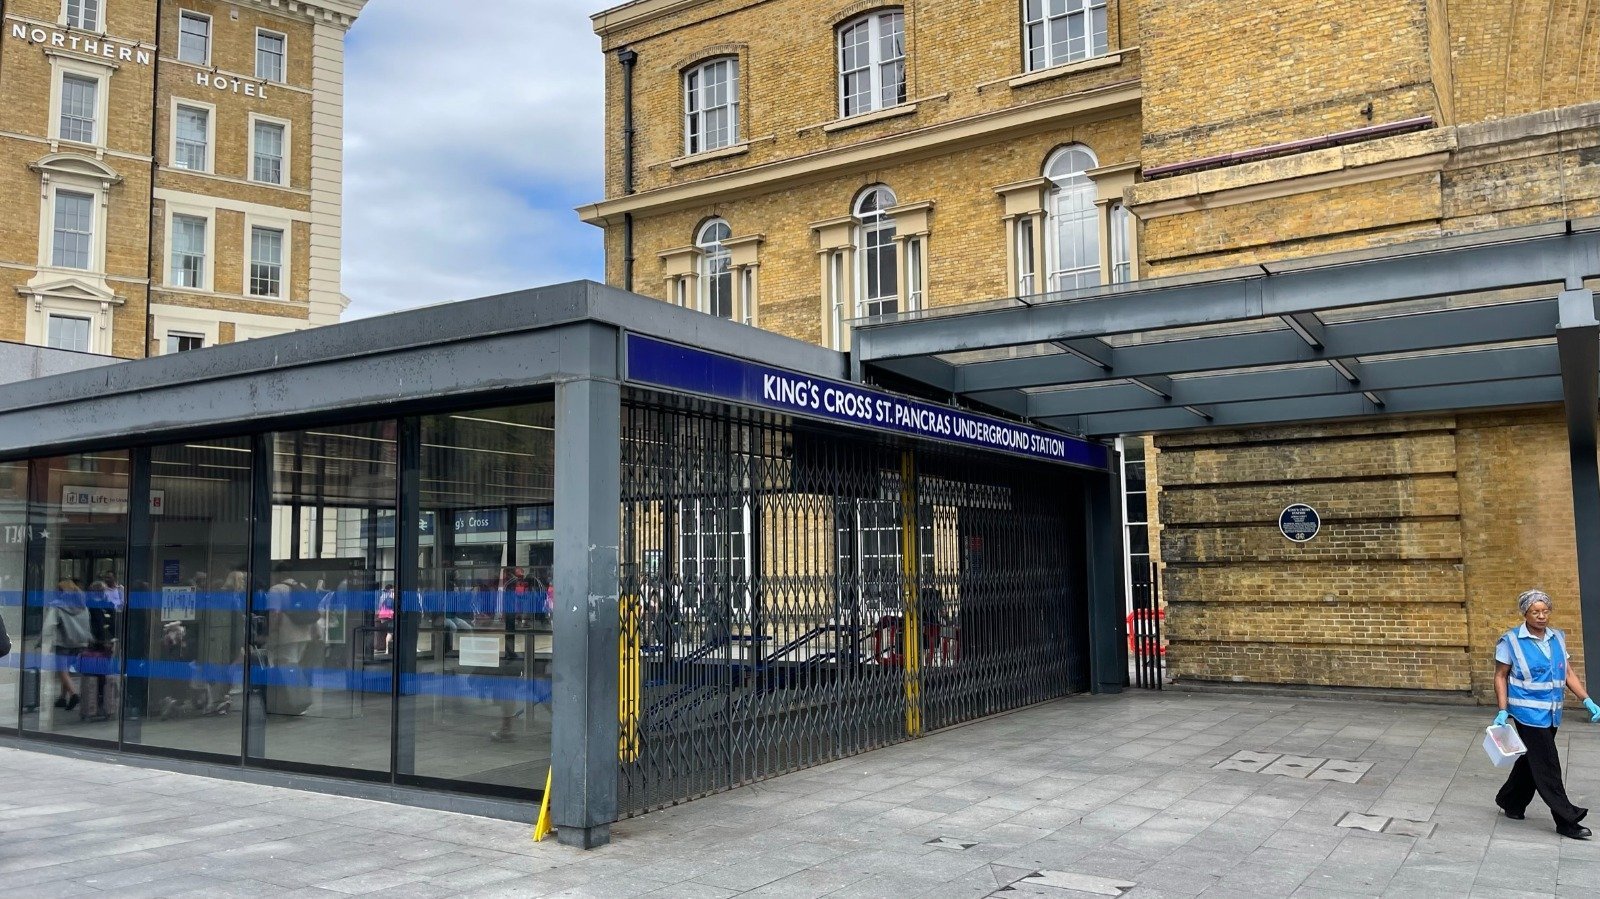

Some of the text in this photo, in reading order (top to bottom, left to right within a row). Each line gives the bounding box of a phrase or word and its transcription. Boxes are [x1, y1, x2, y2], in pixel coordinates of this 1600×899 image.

[12, 24, 150, 64] NORTHERN
[196, 72, 268, 99] HOTEL
[763, 373, 1065, 457] KING'S CROSS ST. PANCRAS UNDERGROUND STATION
[91, 495, 108, 504] Lift
[468, 516, 489, 527] Cross
